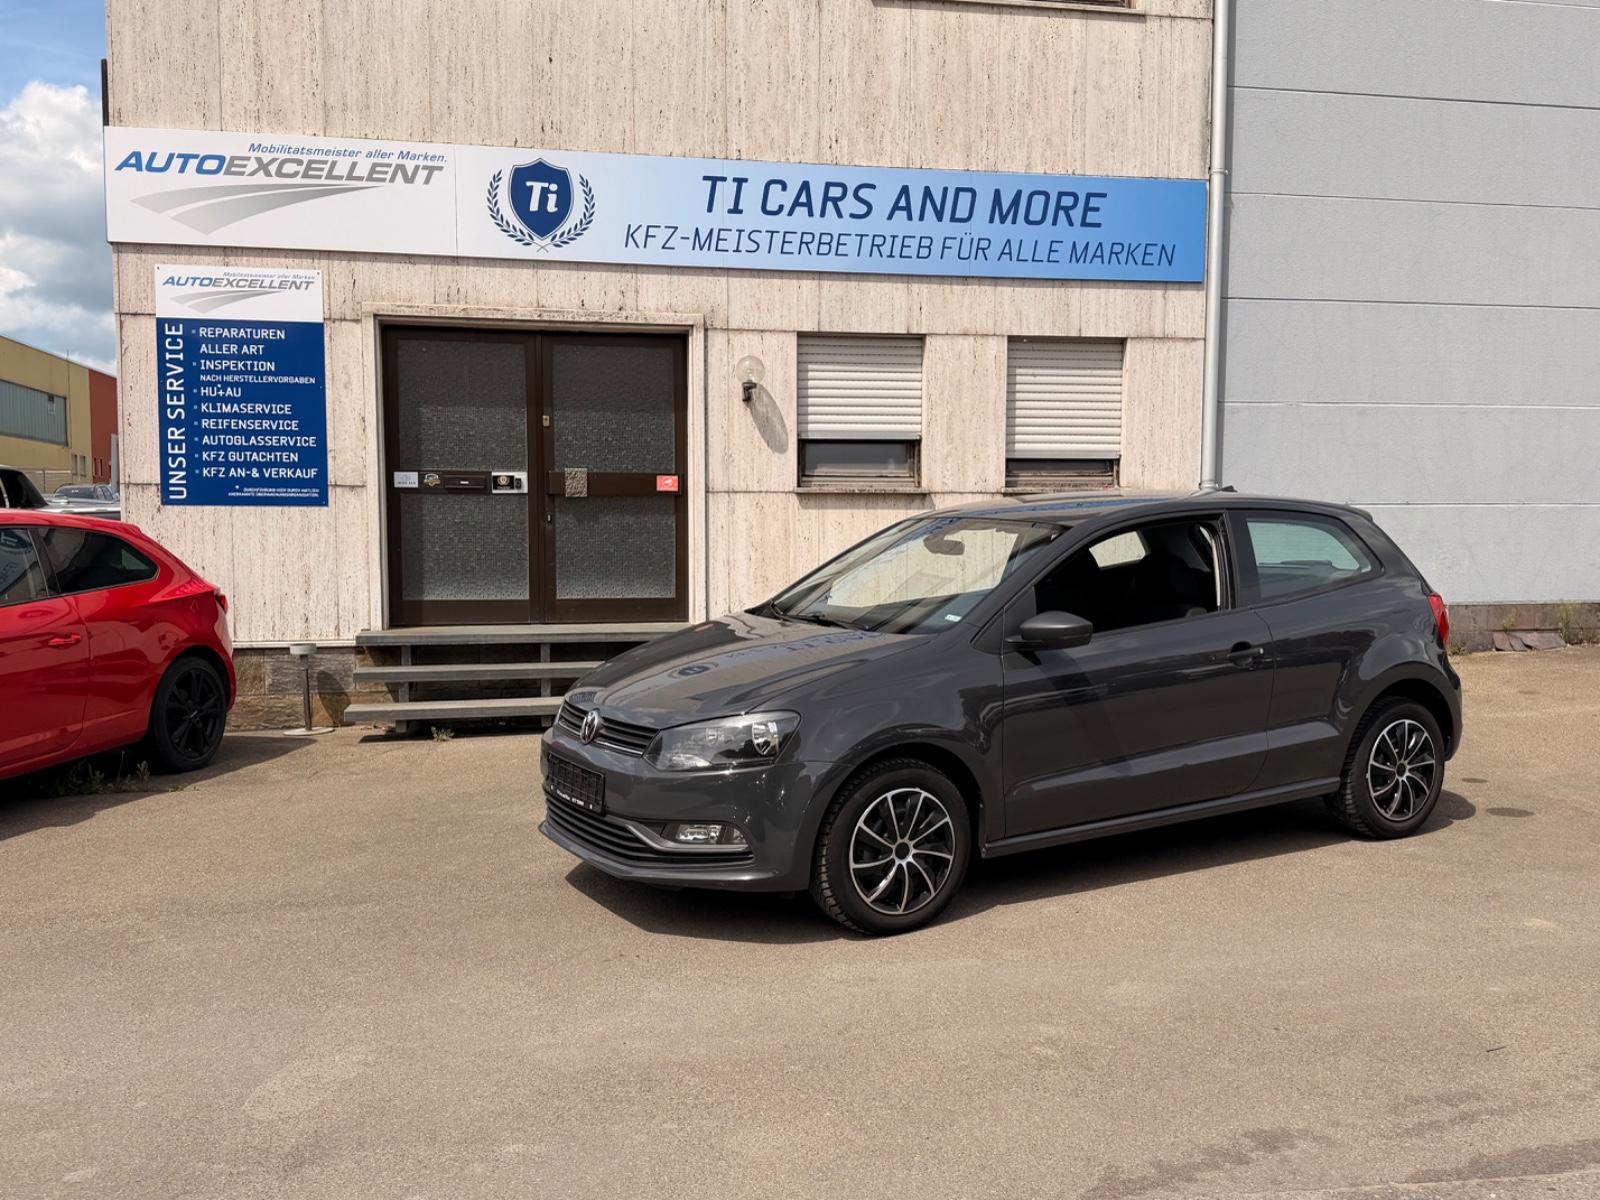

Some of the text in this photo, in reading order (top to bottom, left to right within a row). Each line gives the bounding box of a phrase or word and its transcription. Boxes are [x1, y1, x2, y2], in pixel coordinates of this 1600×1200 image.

[364, 150, 396, 160] aller
[397, 151, 448, 163] Marken.
[115, 151, 444, 185] AUTOEXCELLENT
[524, 180, 560, 213] Ti
[702, 175, 1107, 228] TI CARS AND MORE
[624, 224, 1176, 266] KFZ-MEISTERBETRIEB FÜR ALLE MARKEN
[163, 276, 315, 290] AUTOEXCELLENT
[199, 327, 286, 340] REPARATUREN
[200, 343, 265, 356] ALLER ART
[200, 359, 276, 372] INSPEKTION
[200, 374, 316, 384] NACH HERSTELLERVORGABEN
[165, 323, 187, 499] UNSER SERVICE
[201, 402, 293, 415] KLIMASERVICE
[202, 418, 300, 431] REIFENSERVICE
[202, 435, 317, 447] AUTOGLASSERVICE
[202, 451, 299, 462] KFZ GUTACHTEN
[202, 467, 226, 478] KFZ
[263, 468, 318, 479] VERKAUF
